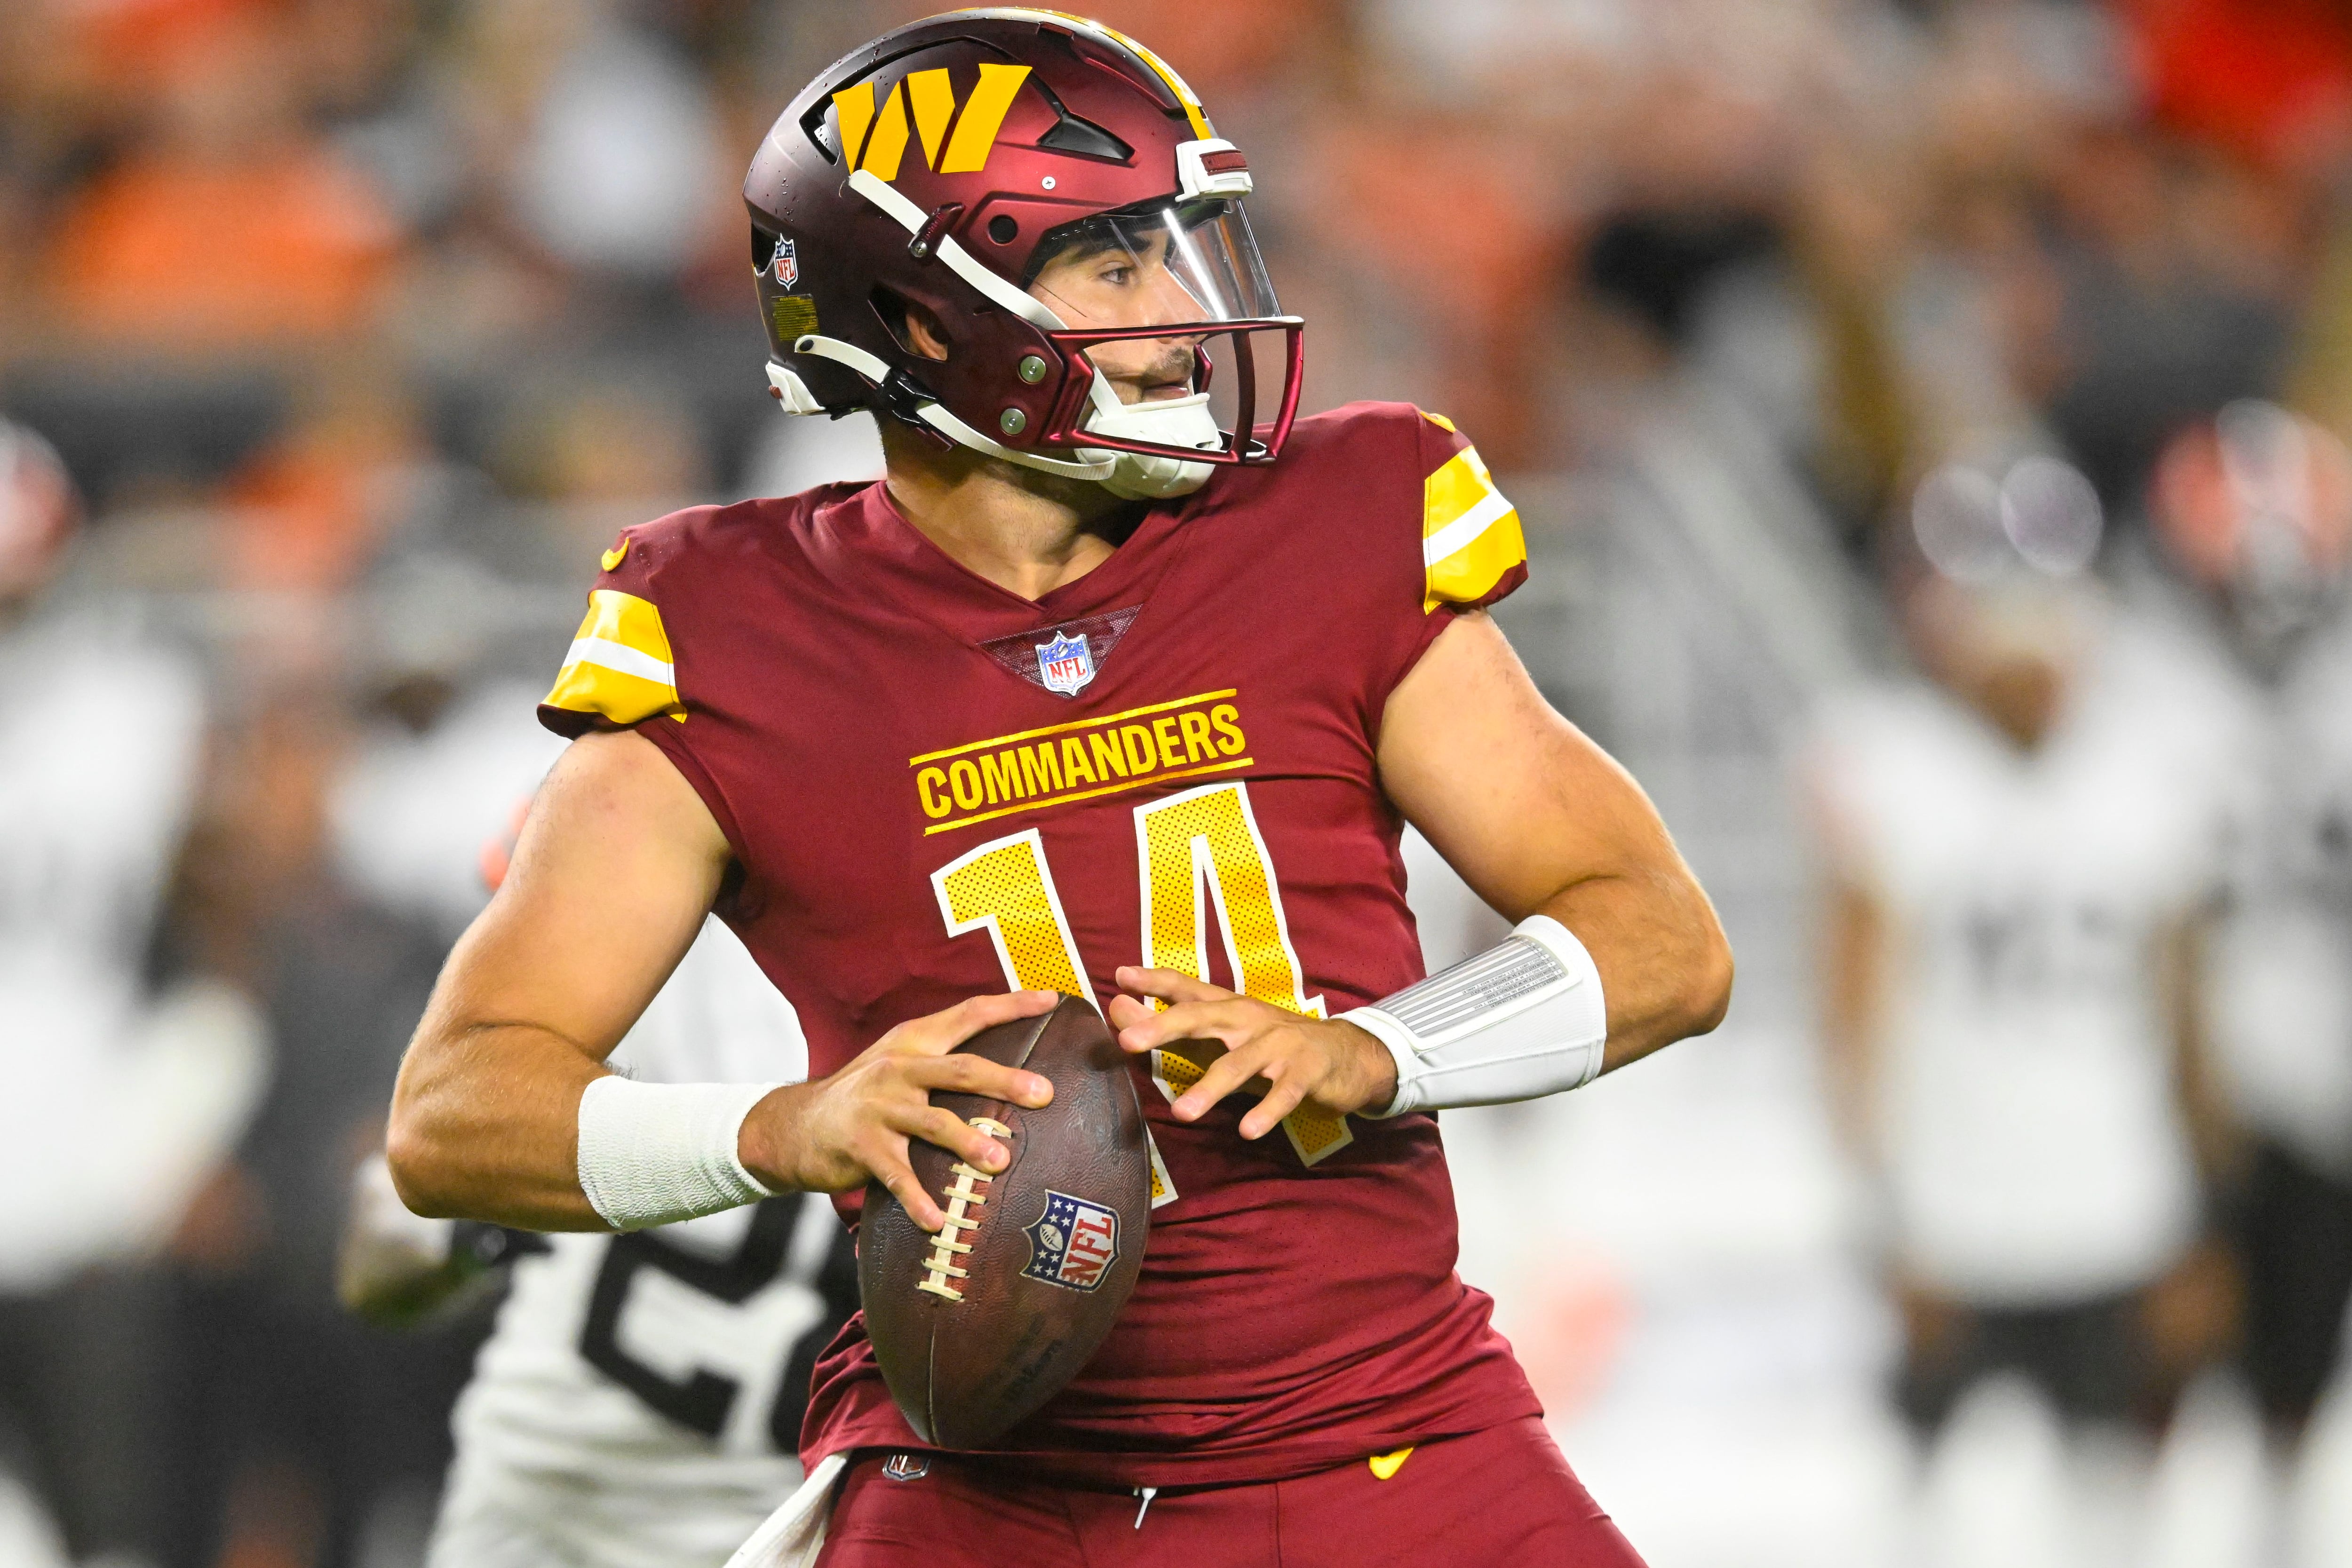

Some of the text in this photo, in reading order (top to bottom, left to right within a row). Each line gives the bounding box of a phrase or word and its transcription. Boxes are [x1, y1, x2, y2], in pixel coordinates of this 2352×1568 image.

[777, 259, 795, 280] NFL
[1048, 657, 1086, 683] NFL
[915, 704, 1246, 818] COMMANDERS
[930, 778, 1354, 1210] 14
[1060, 1217, 1112, 1285] NFL
